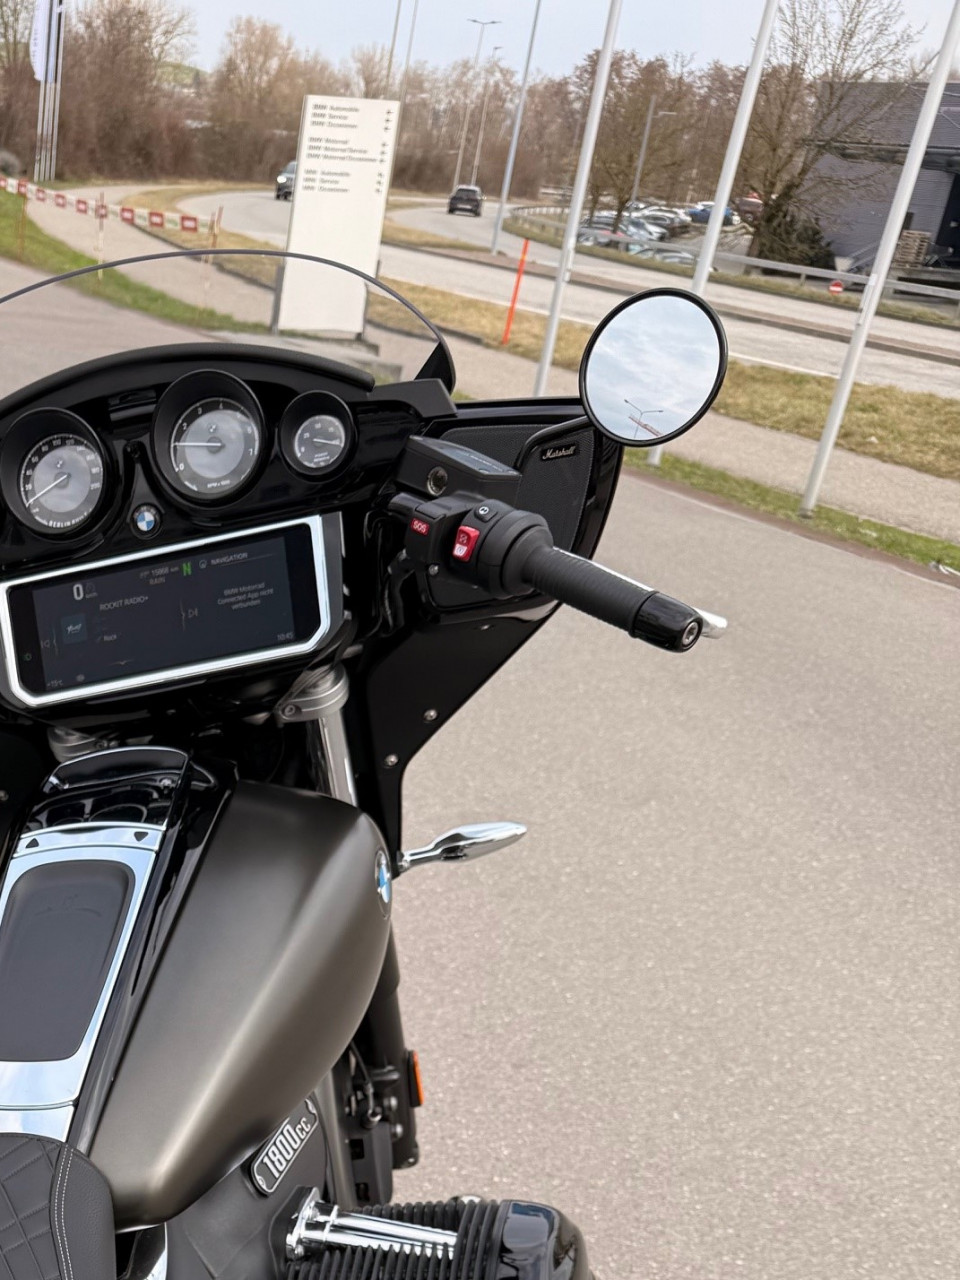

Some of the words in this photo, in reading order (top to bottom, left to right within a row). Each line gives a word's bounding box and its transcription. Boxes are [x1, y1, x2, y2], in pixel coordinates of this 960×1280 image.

[542, 445, 577, 459] Marshall
[412, 519, 428, 533] SOS
[210, 552, 249, 566] NAVIGATION
[182, 562, 192, 576] N
[72, 583, 85, 601] 0
[262, 1117, 311, 1179] 1800cc
